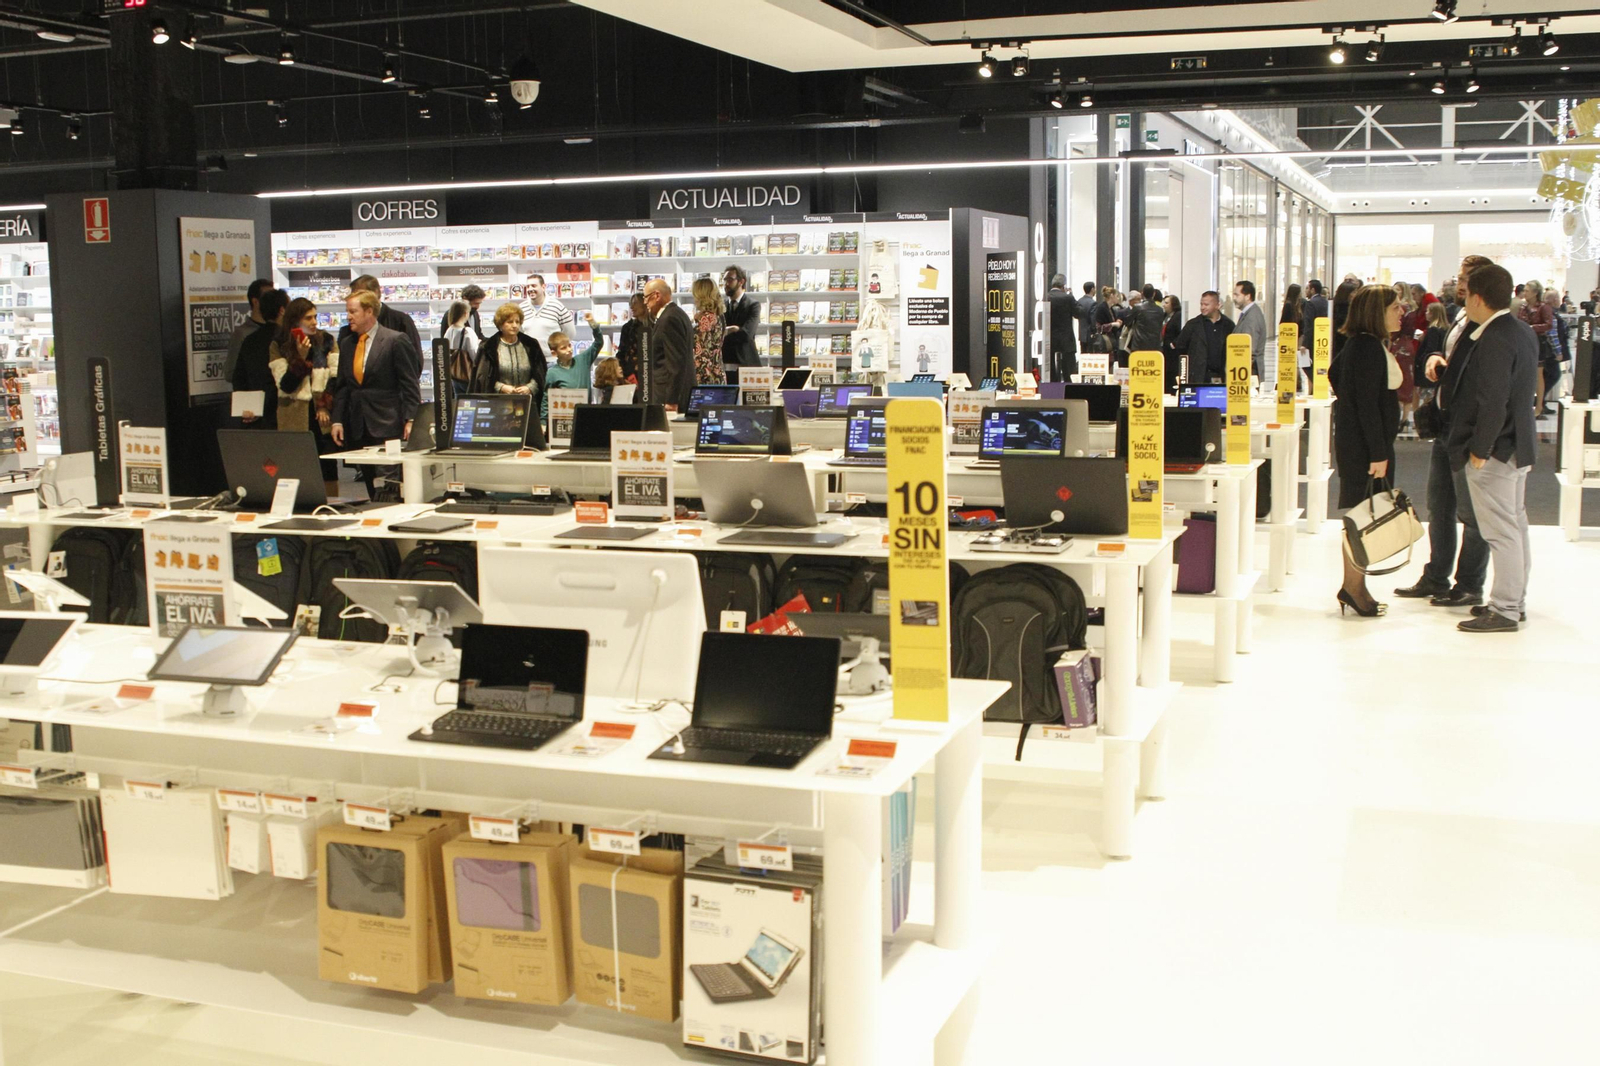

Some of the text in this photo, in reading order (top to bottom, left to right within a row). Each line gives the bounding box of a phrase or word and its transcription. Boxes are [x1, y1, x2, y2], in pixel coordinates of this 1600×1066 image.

[657, 185, 801, 210] ACTUALIDAD
[357, 199, 438, 221] COFRES
[459, 227, 490, 235] experiencia
[540, 224, 571, 232] experiencia
[204, 230, 218, 240] llega
[225, 231, 251, 239] Granada
[988, 259, 1002, 270] PÍDELO
[1003, 259, 1012, 269] HOY
[459, 266, 495, 275] smartbox
[193, 306, 230, 317] AHÓRRATE
[193, 317, 231, 334] EL IVA
[1581, 321, 1591, 341] Apple
[1316, 338, 1328, 347] 10
[1131, 366, 1161, 376] fnac
[1229, 366, 1248, 381] 10
[437, 344, 448, 431] Ordenadores portátiles
[640, 362, 649, 402] Ordenadores
[1228, 385, 1249, 395] SIN
[1132, 393, 1160, 409] 5%
[94, 364, 109, 462] Tabletas Gráficas
[556, 424, 567, 432] EL
[890, 425, 941, 434] FINANCIACIÓN
[957, 428, 969, 437] EL
[901, 436, 930, 444] SOCIOS
[905, 446, 926, 454] FNAC
[1134, 451, 1157, 460] SOCIO
[131, 474, 158, 485] EL IVA
[624, 476, 660, 485] AHÓRRATE
[624, 484, 661, 496] EL IVA
[894, 481, 939, 515] 10
[899, 517, 937, 526] MESES
[191, 535, 220, 543] Granada
[894, 528, 941, 549] SIN
[165, 594, 214, 607] AHÓRRATE
[165, 605, 217, 625] EL IVA
